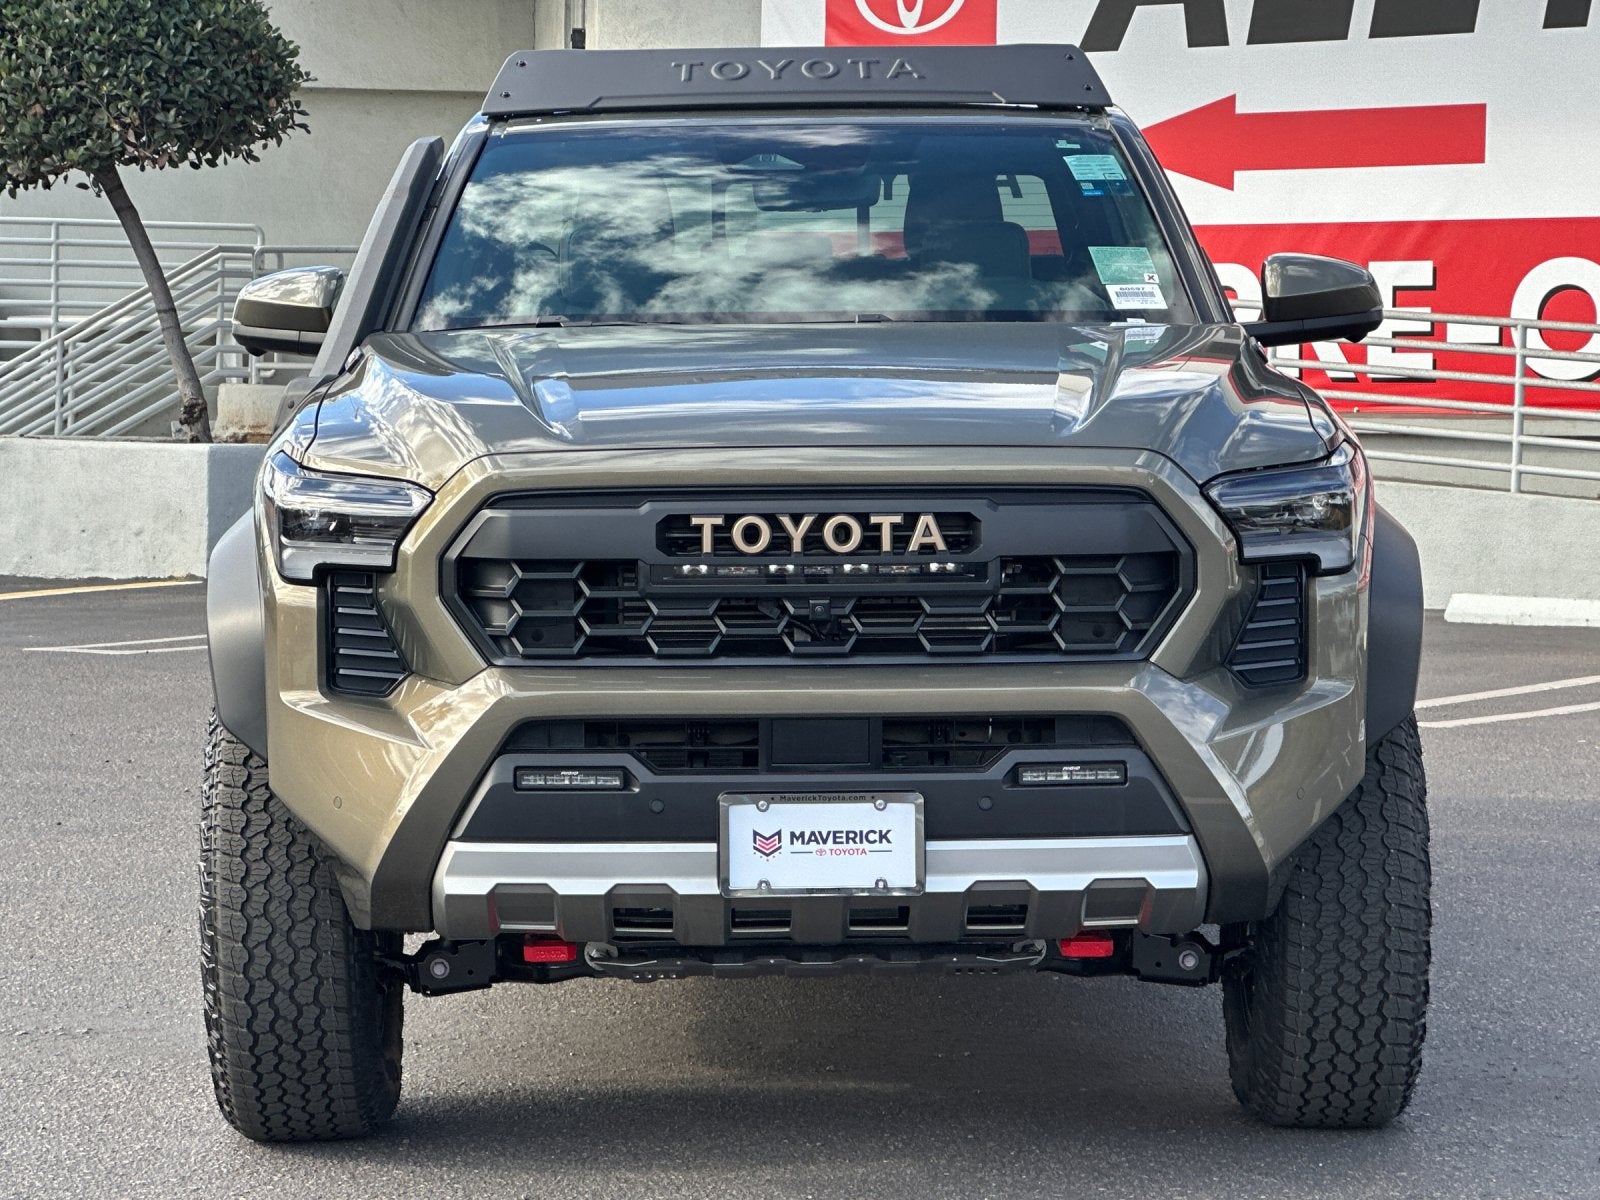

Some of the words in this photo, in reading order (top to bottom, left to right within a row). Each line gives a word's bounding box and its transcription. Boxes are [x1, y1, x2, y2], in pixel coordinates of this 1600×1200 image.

[671, 58, 926, 82] TOYOTA
[690, 513, 948, 556] TOYOTA
[779, 794, 867, 802] MaverickToyota.com
[790, 829, 892, 845] MAVERICK
[829, 848, 867, 856] TOYOTA
